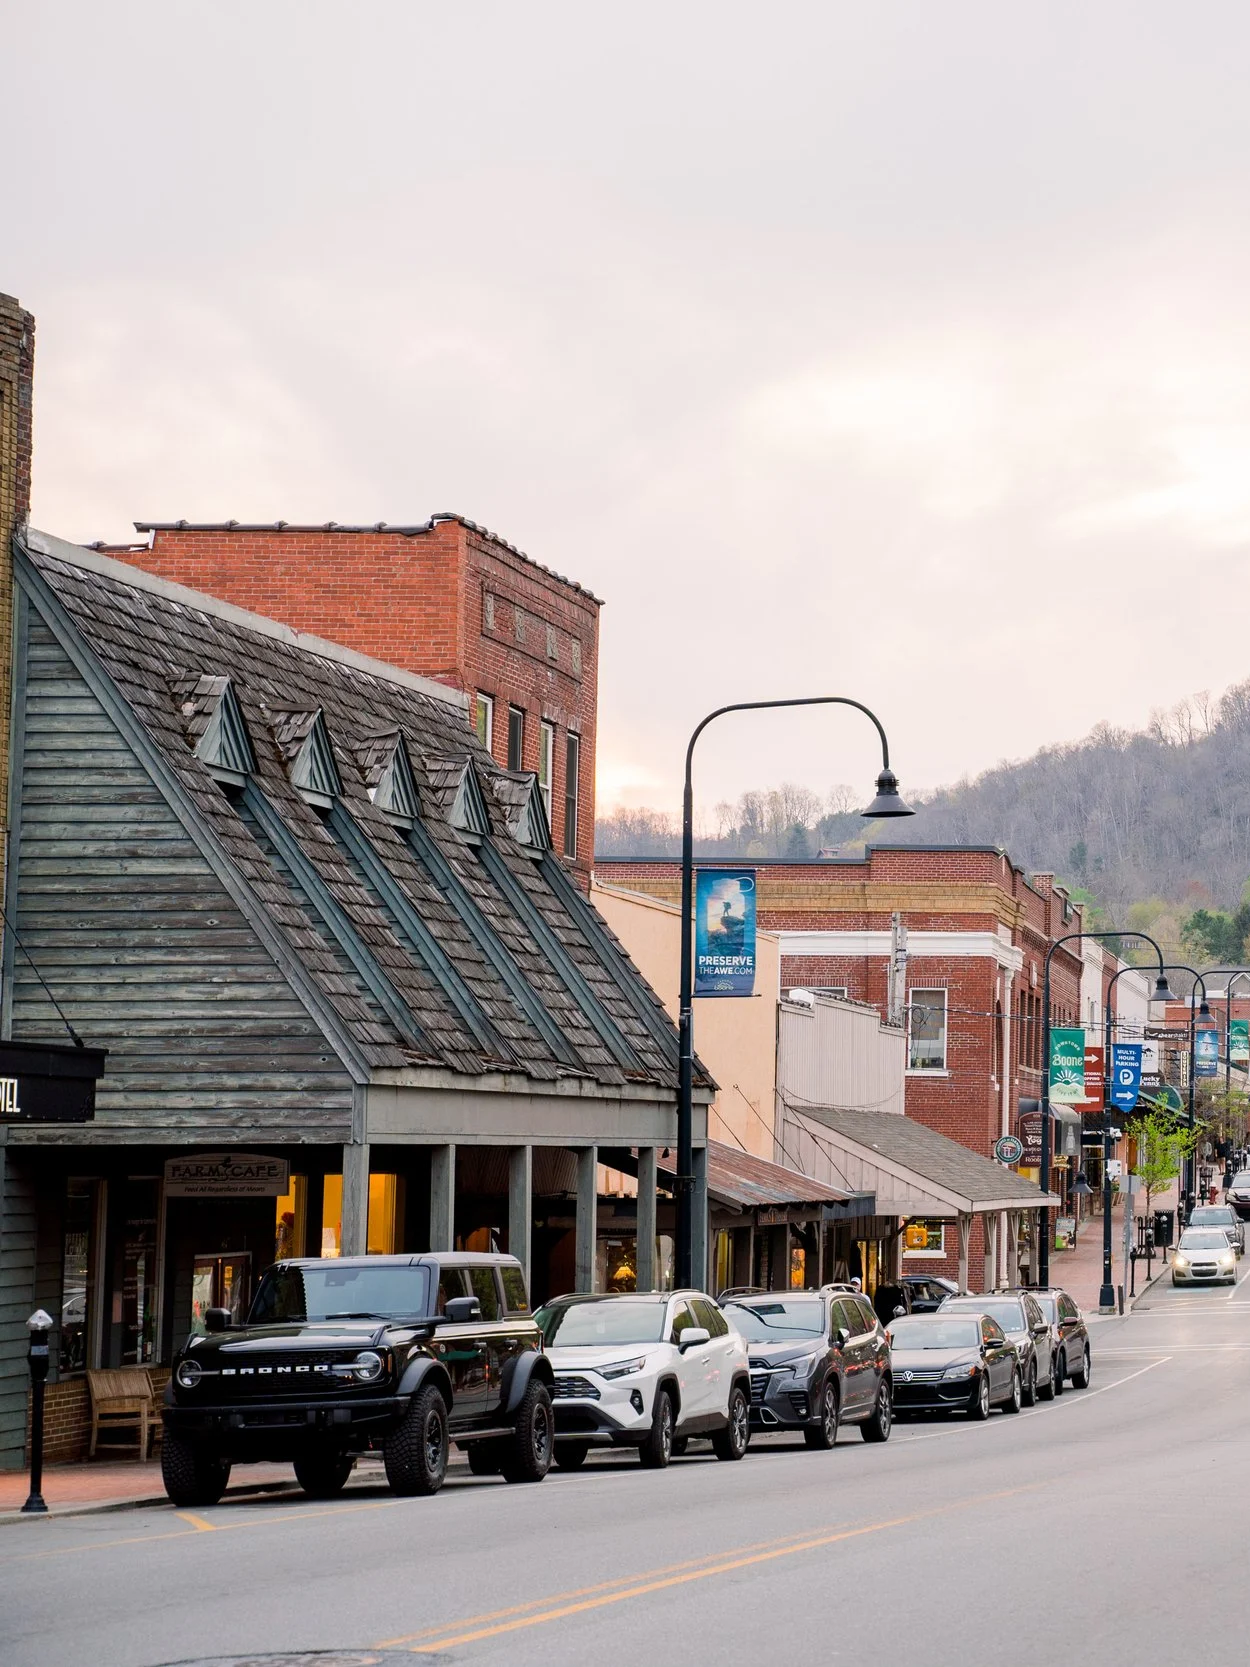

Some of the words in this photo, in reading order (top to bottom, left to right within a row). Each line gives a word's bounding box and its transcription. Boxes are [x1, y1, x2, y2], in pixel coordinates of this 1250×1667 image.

[699, 956, 753, 966] PRESERVE
[699, 966, 753, 975] THEAWE.COM
[1052, 1054, 1083, 1066] Boone
[0, 1078, 21, 1112] TEL
[222, 1365, 328, 1375] BRONCO
